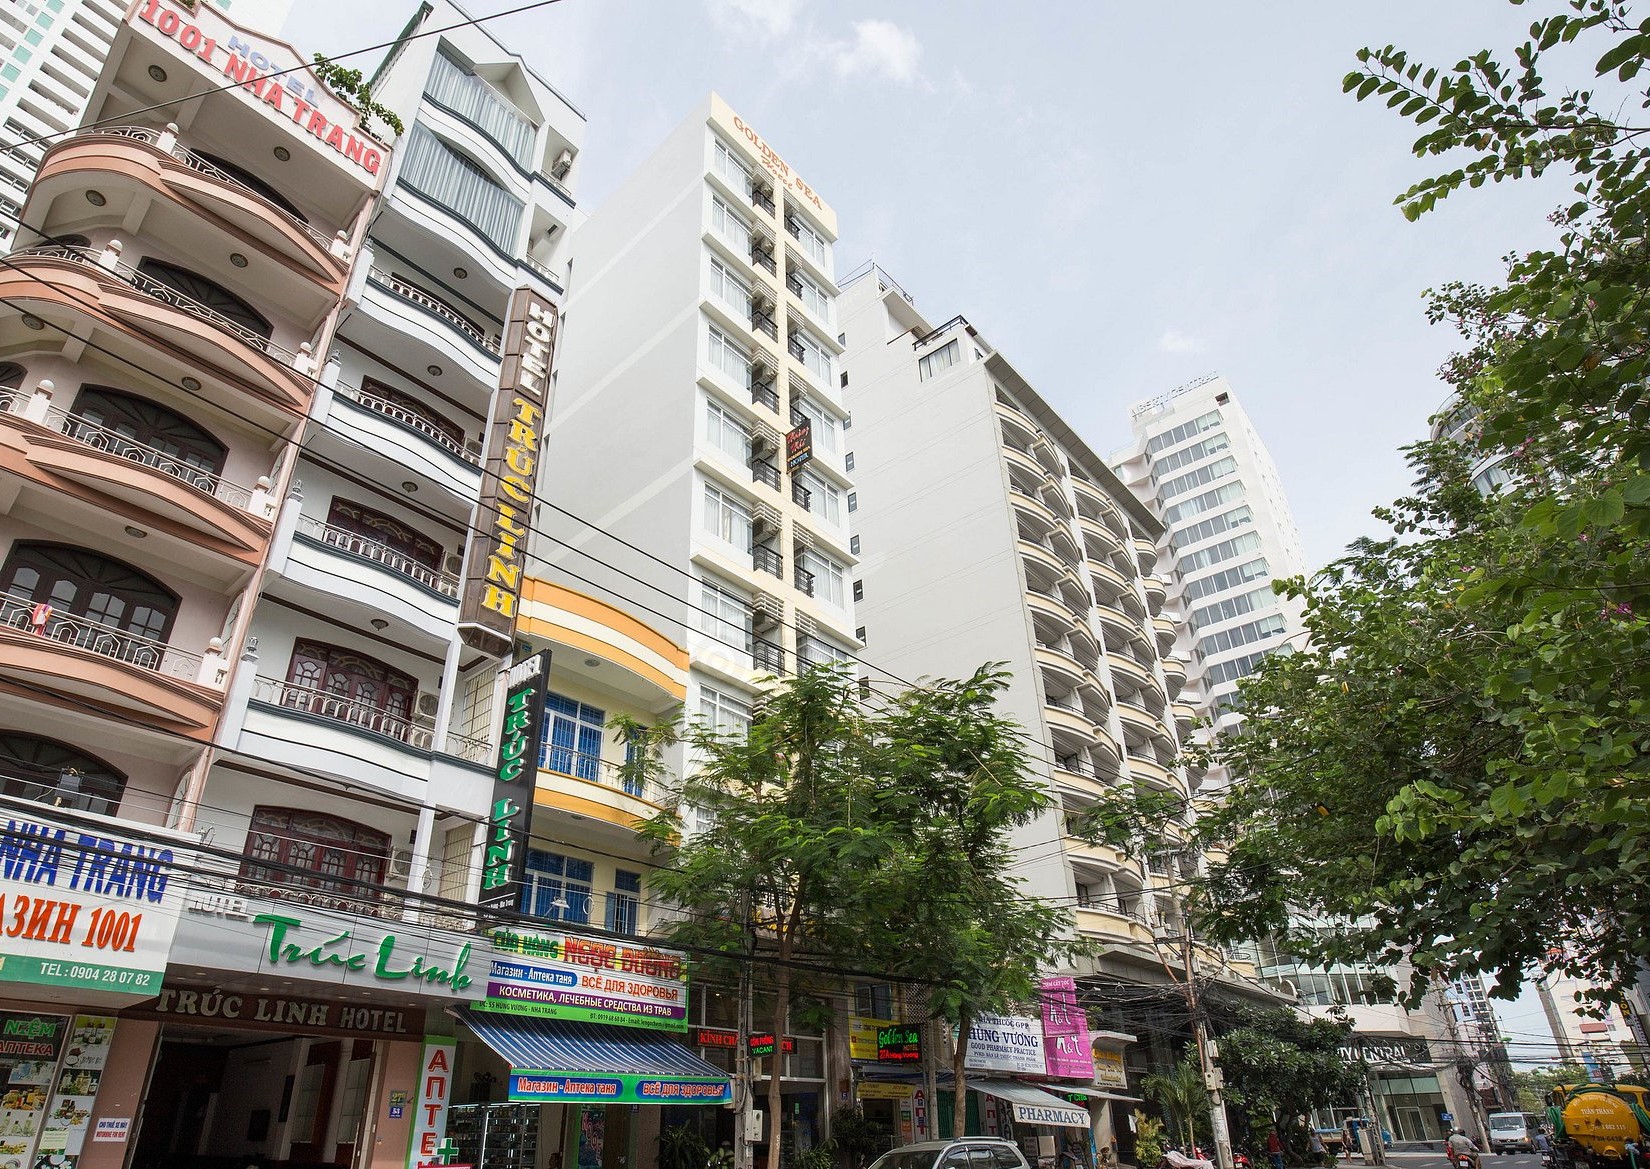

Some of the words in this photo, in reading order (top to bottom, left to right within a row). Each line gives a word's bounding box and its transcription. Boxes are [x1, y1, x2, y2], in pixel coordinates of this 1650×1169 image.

[228, 35, 319, 108] HOTEL
[138, 1, 217, 62] 1001
[224, 53, 283, 111] NHA
[293, 96, 381, 176] TRANG
[734, 116, 789, 177] GOLDEN
[795, 177, 822, 211] SEA
[520, 301, 555, 397] HOTEL
[481, 503, 527, 619] LINH
[483, 797, 519, 890] LINH
[0, 819, 66, 887] NHA
[69, 833, 174, 905] TRANG
[81, 907, 143, 952] 1001
[253, 914, 367, 971] Trúc
[373, 935, 474, 991] Linh
[70, 966, 100, 981] 0904
[103, 970, 117, 983] 28
[119, 972, 133, 985] 07
[135, 974, 151, 987] 82
[528, 967, 555, 984] Аптека
[555, 974, 573, 985] таня
[581, 975, 602, 989] ВСЁ
[604, 978, 626, 993] ДЛЯ
[627, 983, 679, 1001] ЗДОРОВЬЯ
[155, 988, 243, 1019] TRÚC
[254, 999, 330, 1027] LINH
[340, 1007, 407, 1034] HOTEL
[499, 986, 557, 1004] КОСМЕТИКА,
[558, 993, 602, 1009] ЛЕЧЕБНЫЕ
[603, 999, 642, 1015] СРЕДСТВА
[642, 1005, 653, 1015] ИЗ
[653, 1006, 672, 1017] ТРАВ
[541, 1007, 557, 1015] TRANG
[752, 1046, 774, 1054] VACANT
[905, 1030, 919, 1044] Sea
[970, 1042, 986, 1051] GOOD
[986, 1043, 1013, 1053] PHARMACY
[1013, 1047, 1037, 1056] PRACTICE
[1001, 1031, 1039, 1048] VƯƠNG
[517, 1077, 558, 1093] Магазин
[563, 1079, 595, 1095] Аптека
[596, 1084, 616, 1095] таня
[642, 1082, 660, 1096] ВСЁ
[661, 1084, 679, 1097] ДЛЯ
[680, 1085, 724, 1097] ЗДОРОВЬЯ
[1018, 1106, 1085, 1125] PHARMACY
